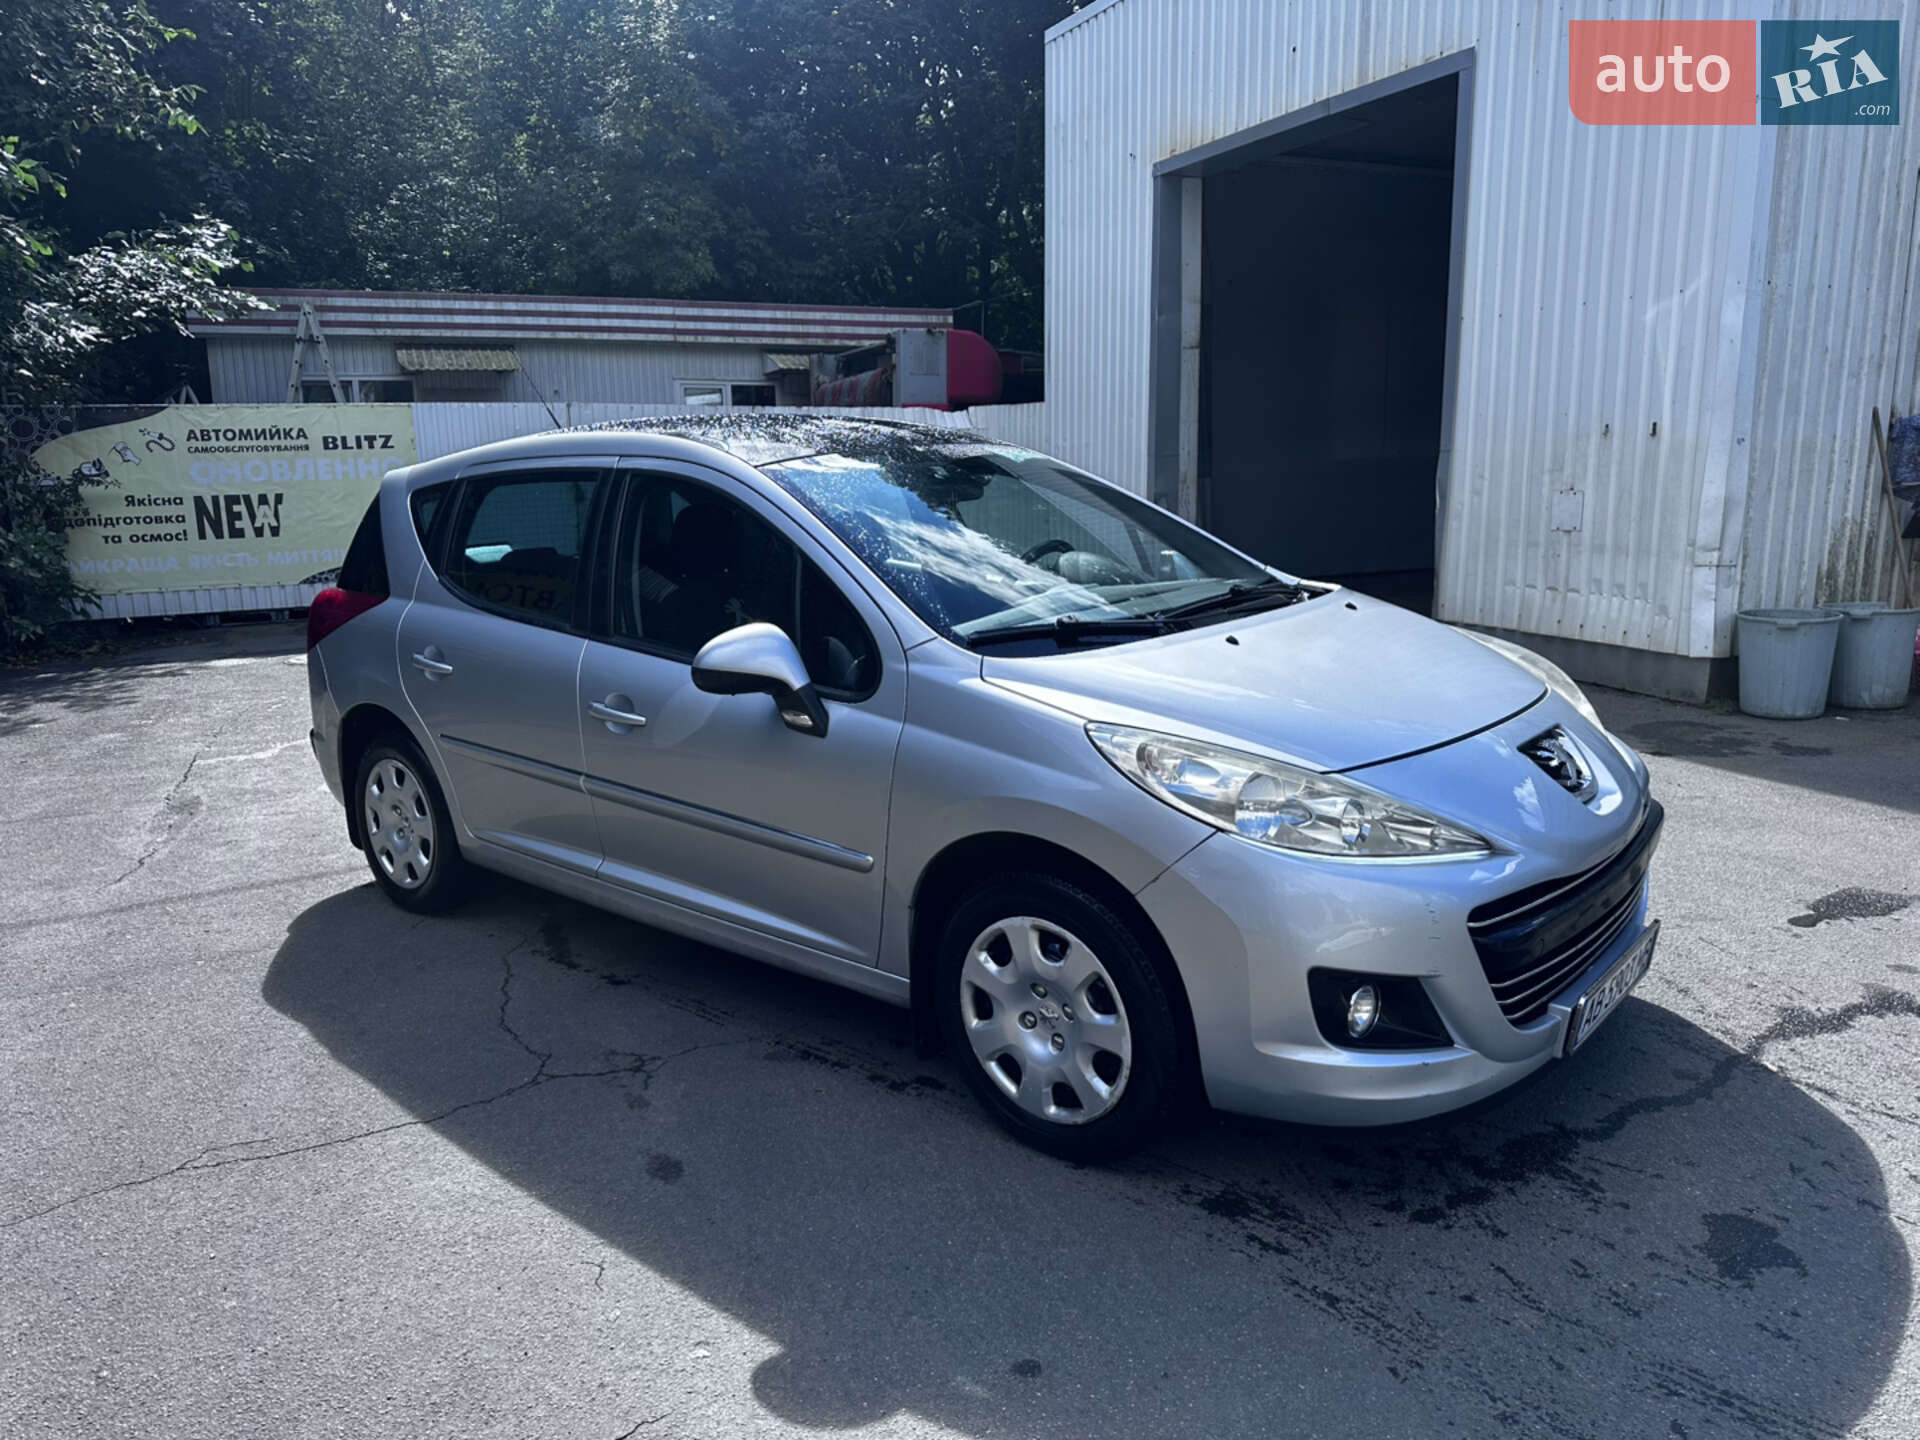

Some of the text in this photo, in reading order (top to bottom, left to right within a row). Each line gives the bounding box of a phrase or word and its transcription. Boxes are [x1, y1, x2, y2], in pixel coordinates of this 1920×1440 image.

[186, 425, 308, 442] АВТОМИЙКА
[322, 434, 394, 451] BLITZ
[124, 494, 184, 507] Якісна
[193, 493, 284, 541] NEW
[103, 529, 189, 545] та осмос!
